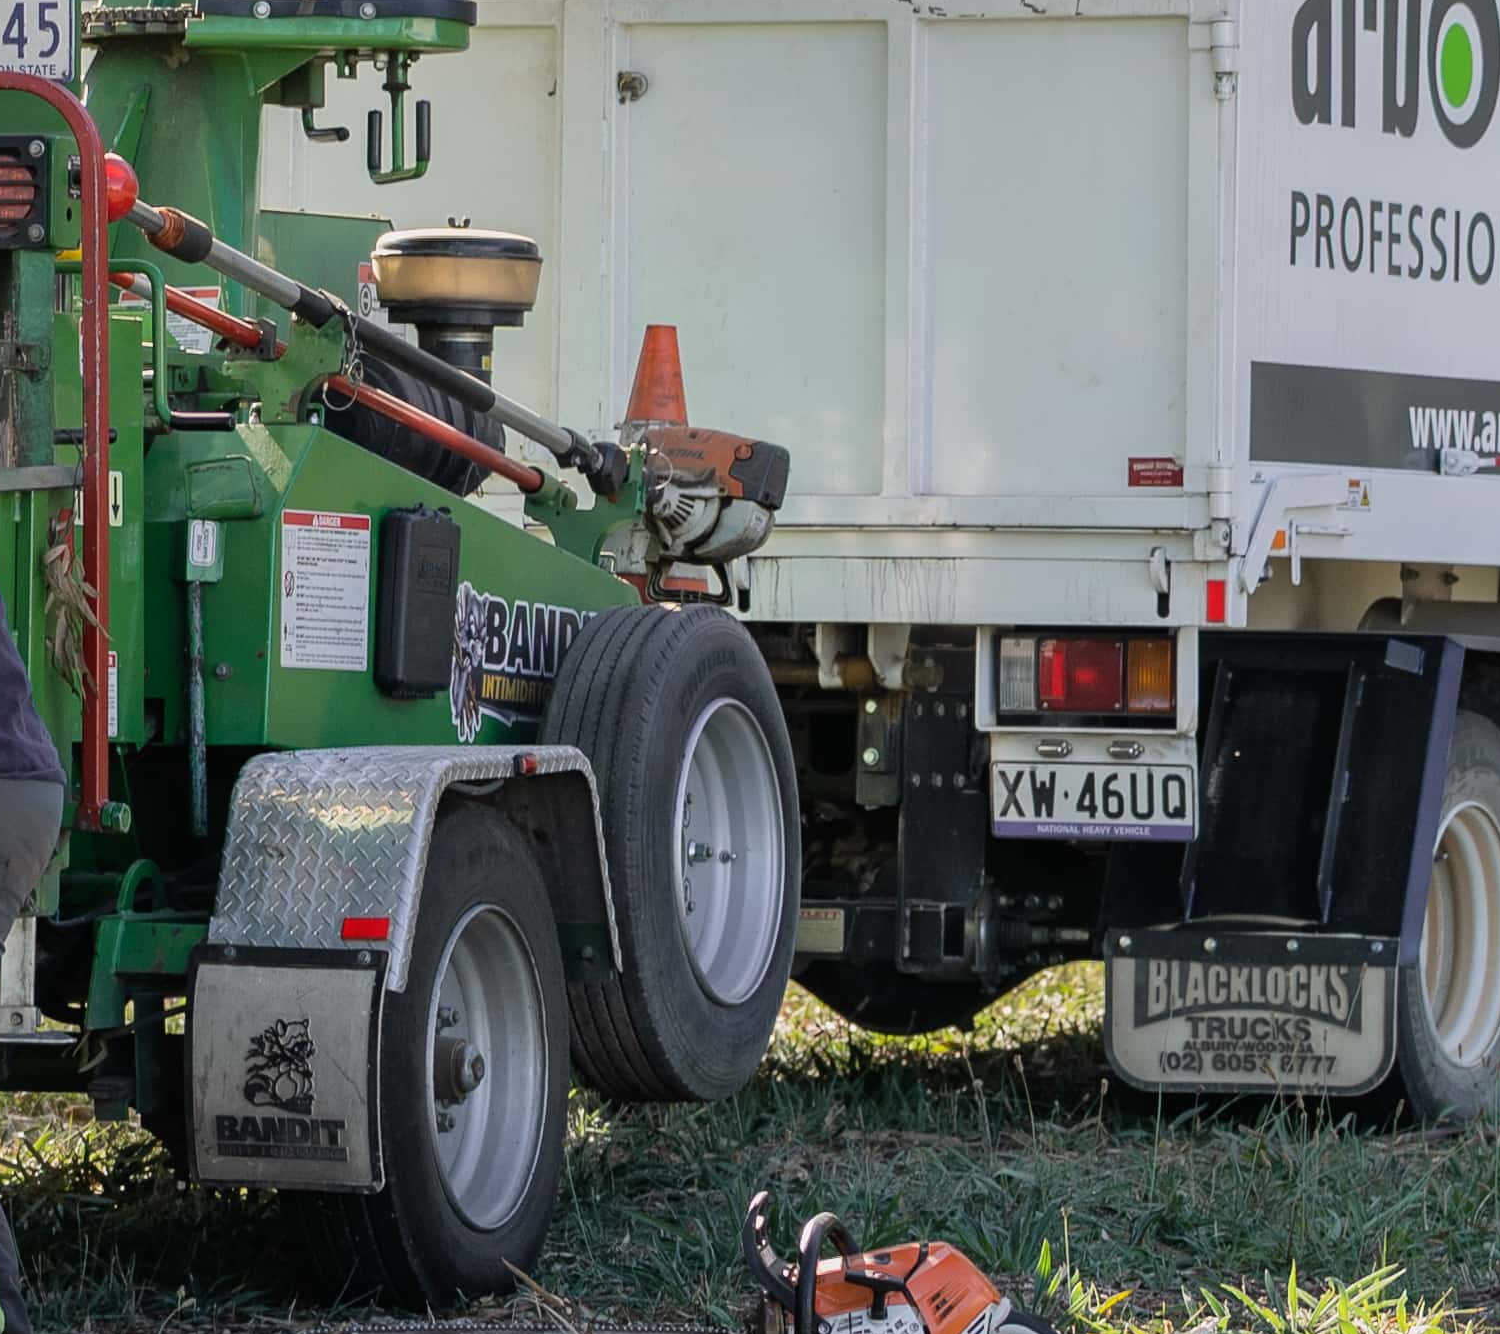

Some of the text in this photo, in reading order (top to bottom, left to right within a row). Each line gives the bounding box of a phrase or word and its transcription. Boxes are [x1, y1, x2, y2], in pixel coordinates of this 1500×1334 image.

[19, 64, 57, 76] STATE
[482, 596, 598, 678] BAND
[482, 674, 552, 702] INTIMIDATO
[1037, 825, 1150, 836] NATIONAL HEAVY VEHICLE
[1147, 959, 1349, 1021] BLACKLOCKS
[1184, 1017, 1312, 1042] TRUCKS
[1160, 1051, 1204, 1074] (02)
[216, 1115, 347, 1147] BANDIT
